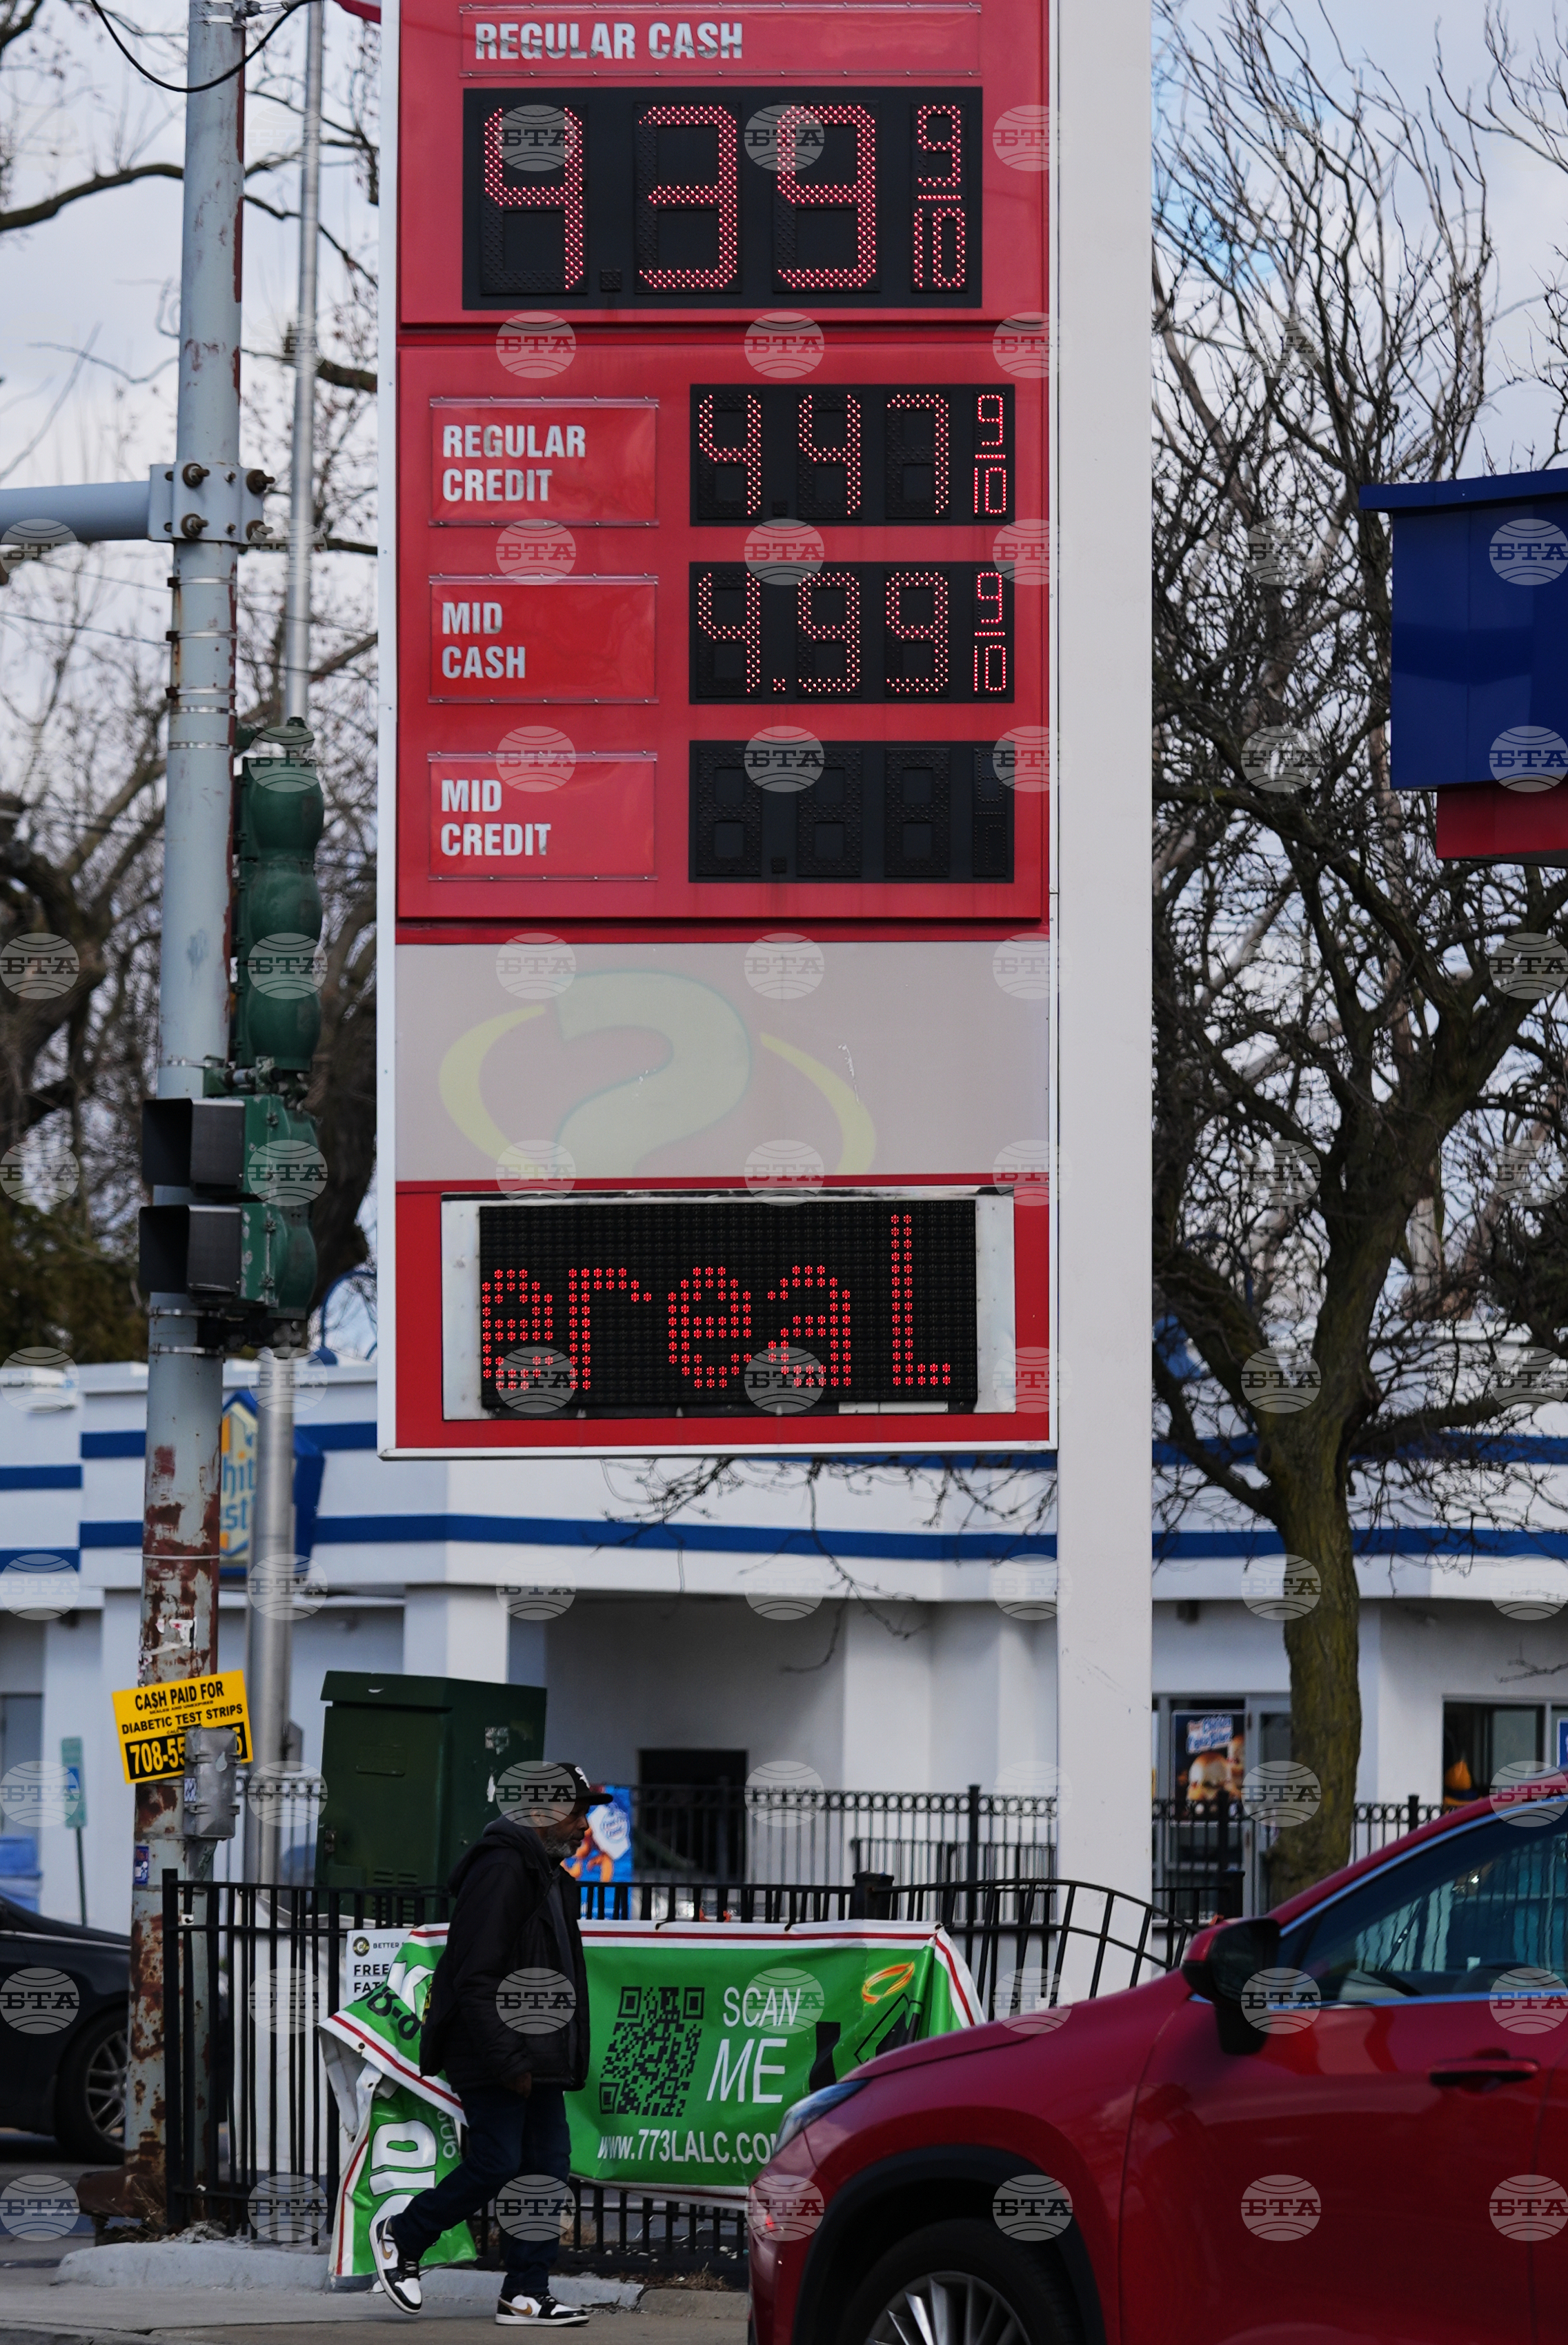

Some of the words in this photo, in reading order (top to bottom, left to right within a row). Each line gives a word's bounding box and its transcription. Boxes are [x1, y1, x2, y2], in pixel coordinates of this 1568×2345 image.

[475, 23, 636, 59] REGULAR
[649, 23, 743, 59] CASH
[443, 425, 586, 458] REGULAR
[442, 469, 553, 502] CREDIT
[442, 602, 503, 635] MID
[441, 646, 526, 679] CASH
[441, 780, 502, 812] MID
[440, 824, 551, 856] CREDIT
[170, 1685, 197, 1705] PAID
[200, 1681, 224, 1700] FOR
[121, 1716, 172, 1734] DIABETIC
[175, 1711, 202, 1725] TEST
[206, 1703, 243, 1719] STRIPS
[354, 1963, 389, 1976] FREE
[723, 1986, 801, 2027] SCAN
[706, 2038, 787, 2103] ME
